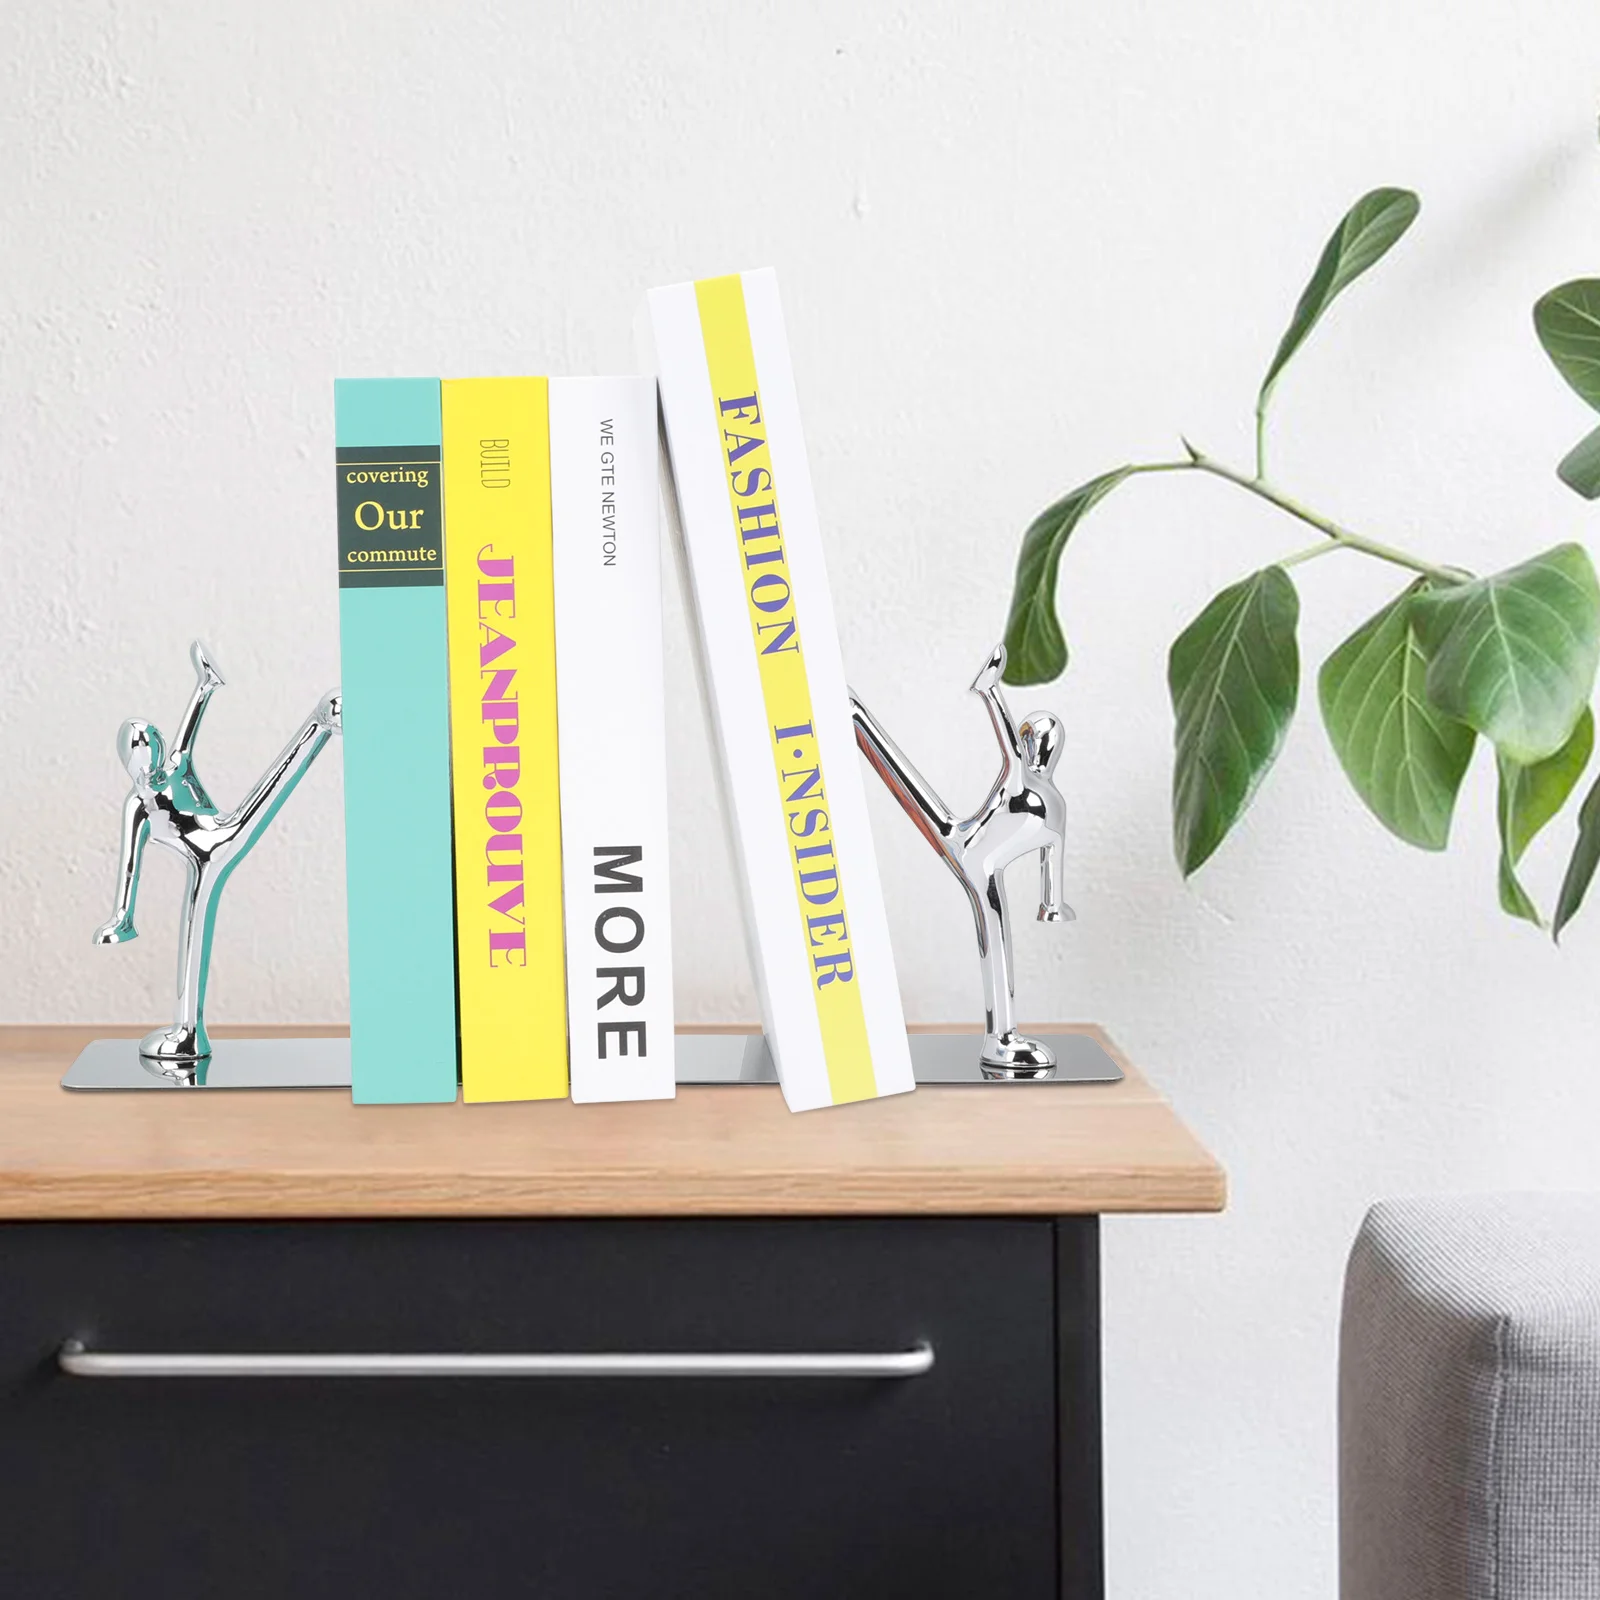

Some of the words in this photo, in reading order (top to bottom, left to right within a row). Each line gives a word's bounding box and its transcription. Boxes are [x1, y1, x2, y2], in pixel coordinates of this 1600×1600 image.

[599, 418, 614, 446] WE
[346, 466, 429, 488] covering
[479, 439, 511, 489] BUILD
[601, 452, 615, 486] GTE
[354, 501, 424, 531] Our
[602, 491, 617, 567] NEWTON
[718, 391, 800, 655] FASHION
[347, 547, 437, 563] commute
[593, 845, 647, 1060] MORE
